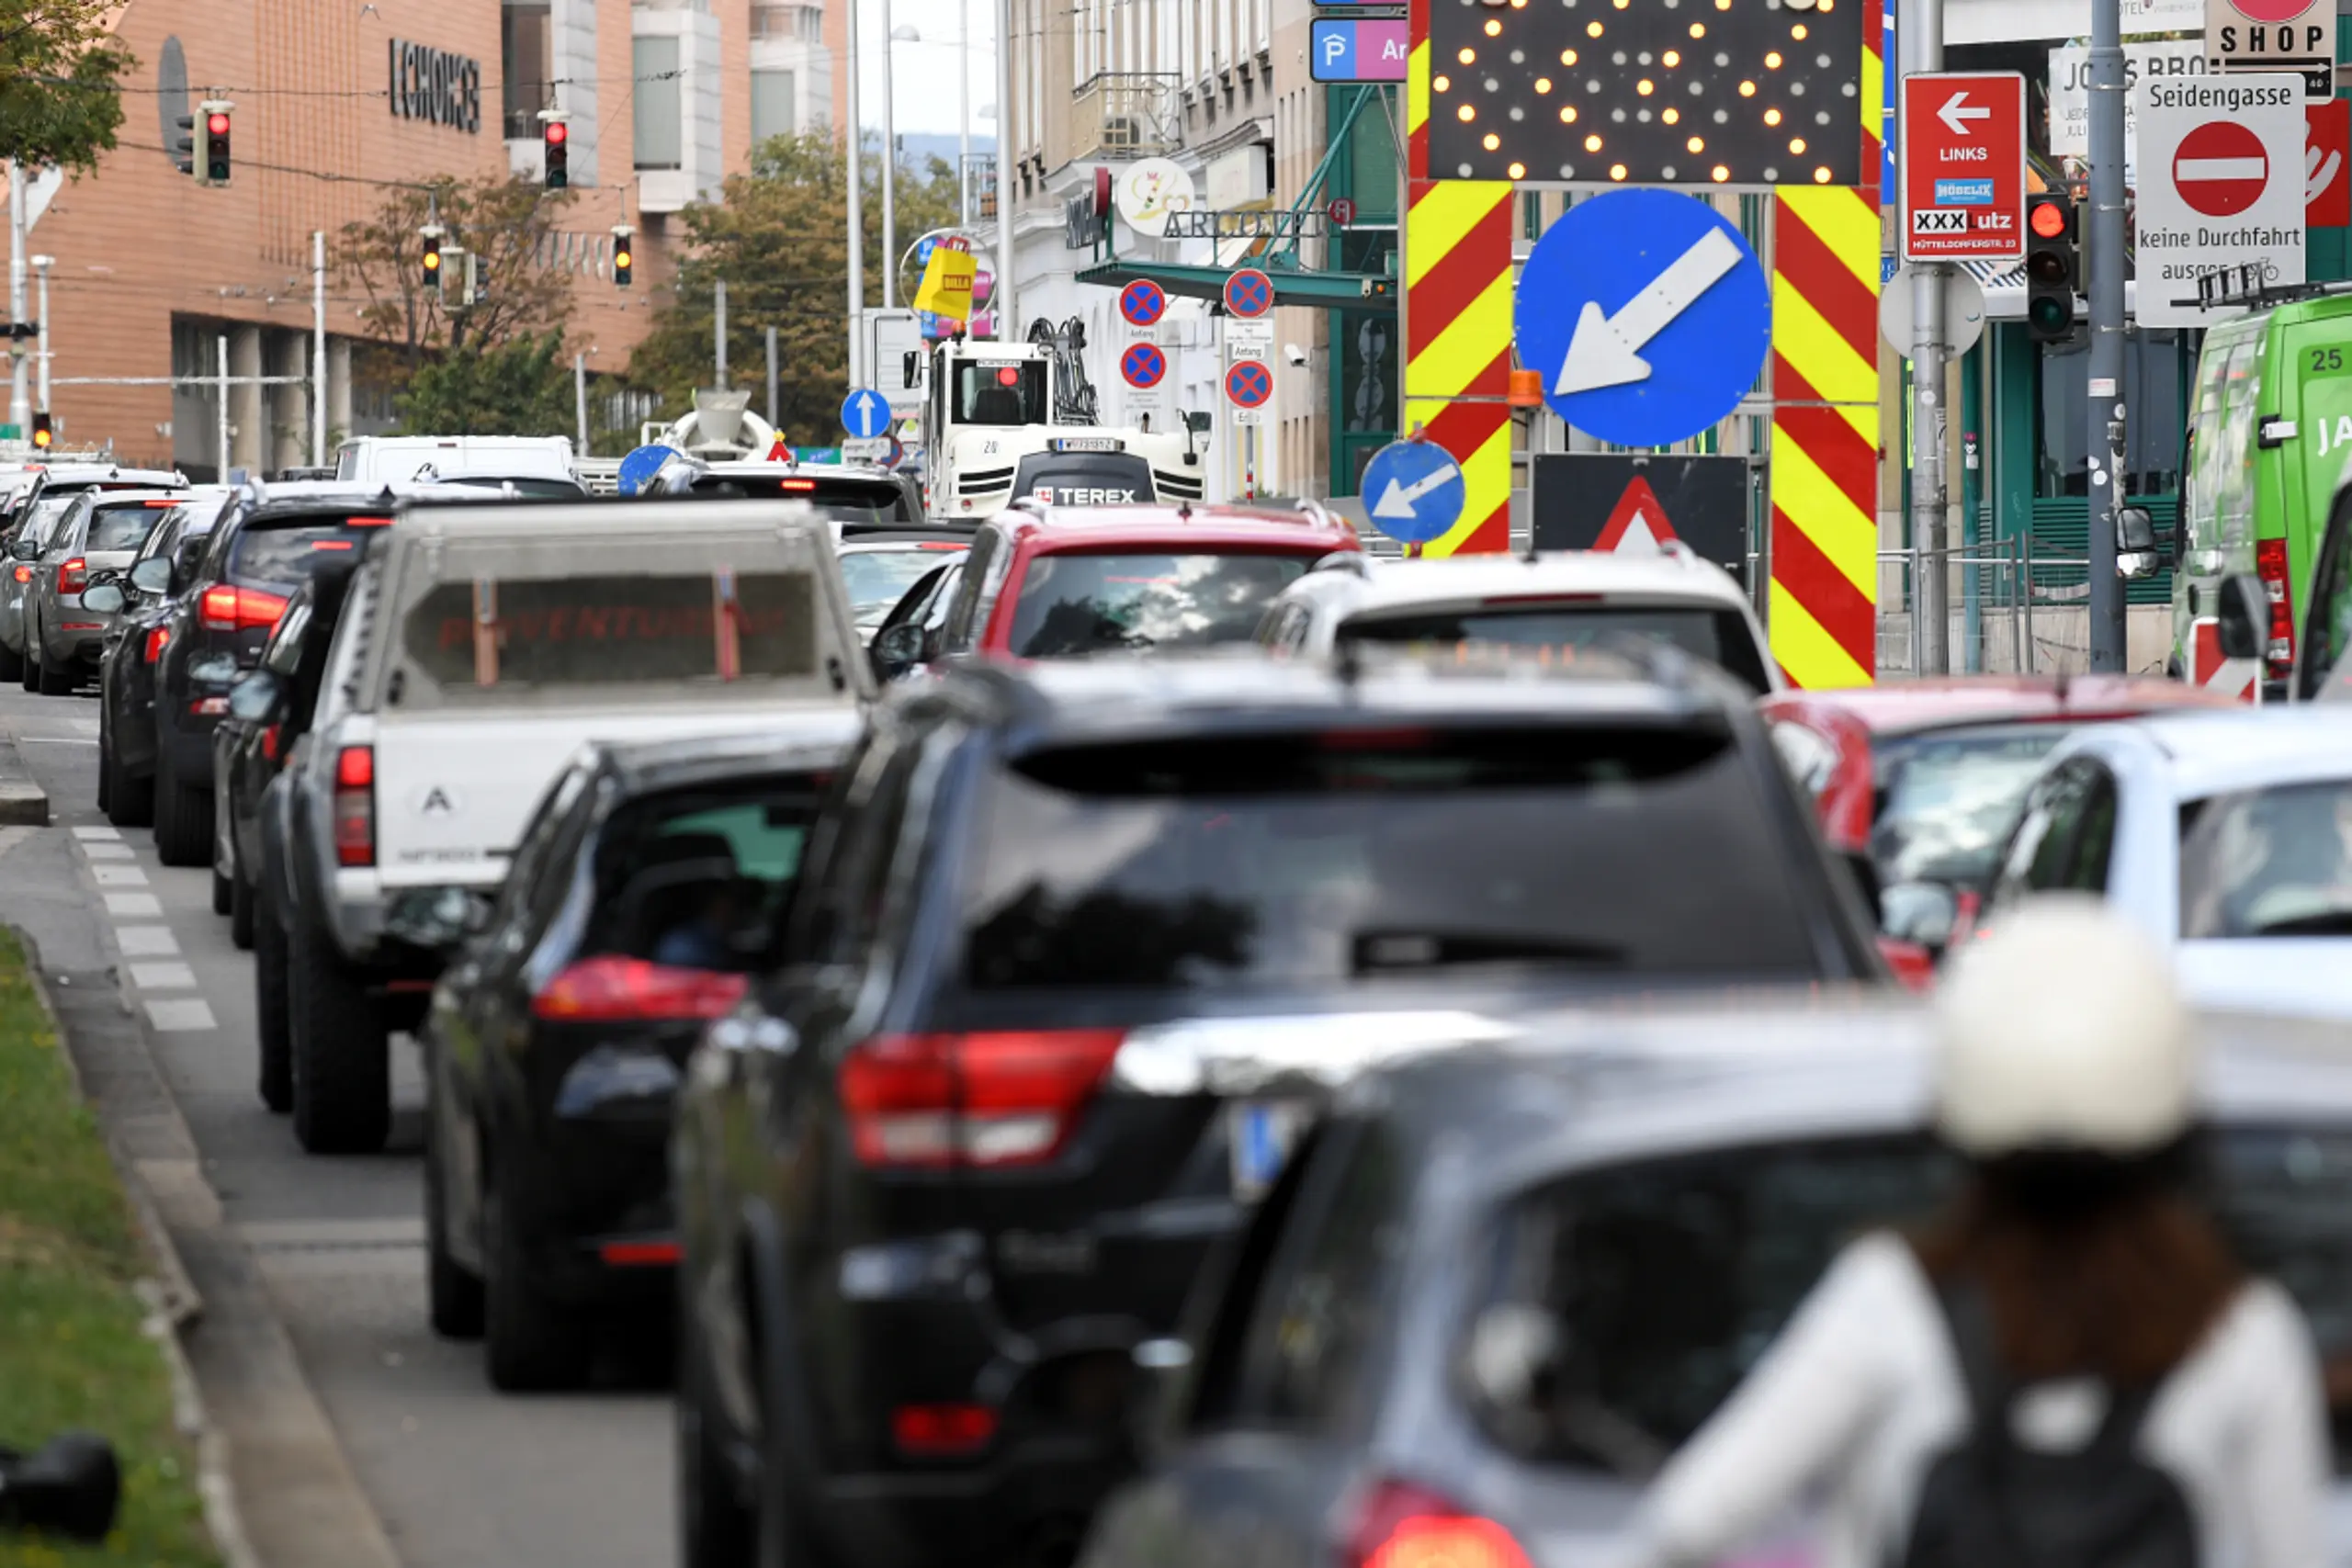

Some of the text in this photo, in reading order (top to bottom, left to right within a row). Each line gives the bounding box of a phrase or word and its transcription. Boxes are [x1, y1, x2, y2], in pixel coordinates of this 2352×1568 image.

[1382, 39, 1408, 60] Ar
[2221, 26, 2323, 52] SHOP
[2150, 84, 2291, 111] Seidengasse
[1940, 147, 1988, 162] LINKS
[2140, 227, 2301, 248] keine Durchfahrt
[1235, 346, 1261, 357] Anfang
[2312, 348, 2343, 372] 25
[1058, 487, 1136, 504] TEREX
[422, 785, 453, 813] A
